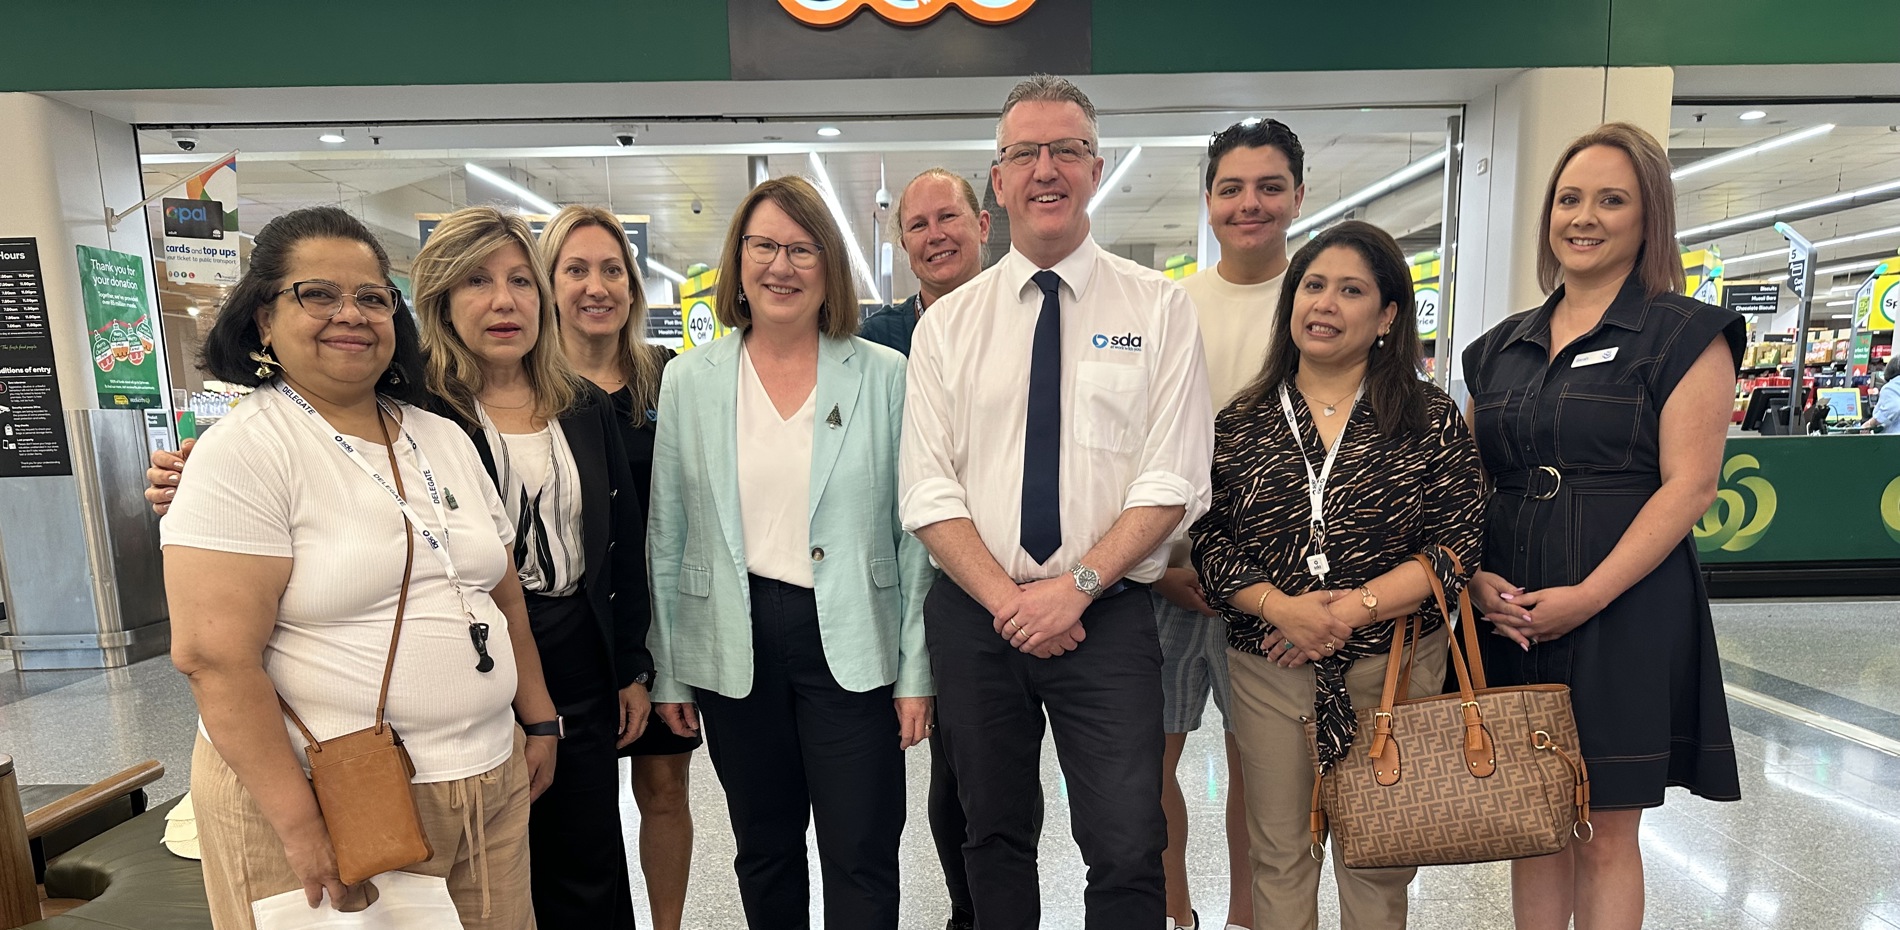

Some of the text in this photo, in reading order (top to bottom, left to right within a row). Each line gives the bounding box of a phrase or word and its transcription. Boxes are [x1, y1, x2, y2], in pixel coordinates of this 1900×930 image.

[166, 206, 207, 224] opal
[166, 244, 190, 253] cards
[203, 246, 217, 257] top
[219, 249, 236, 258] ups
[1791, 249, 1797, 259] 5
[90, 258, 136, 276] Thank you for
[92, 276, 109, 286] your
[690, 317, 713, 332] 40%
[1110, 332, 1142, 347] sda
[0, 366, 24, 374] ditions
[33, 366, 51, 374] entry
[282, 385, 316, 415] DELEGATE
[373, 473, 406, 506] DELEGATE
[423, 469, 440, 504] DELEGATE
